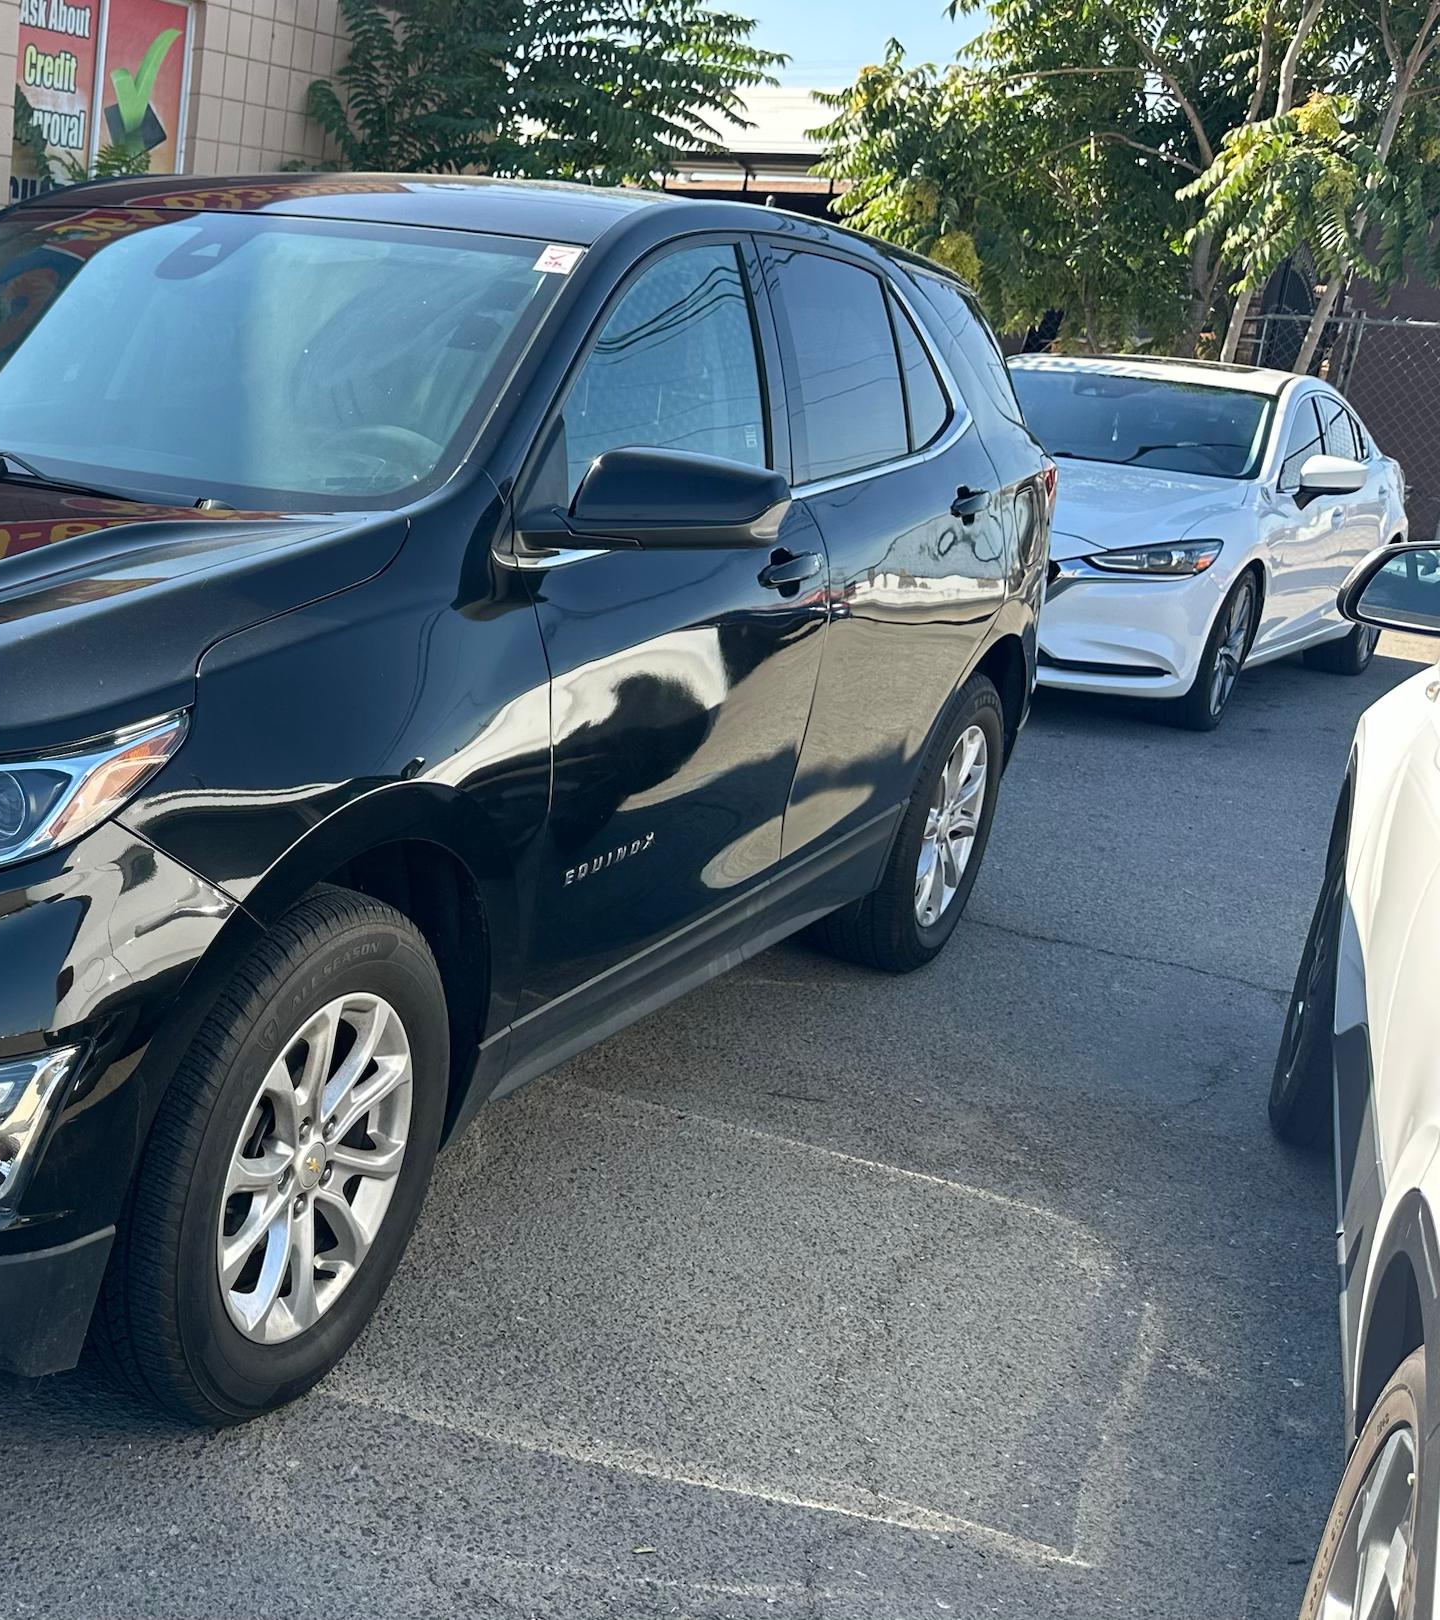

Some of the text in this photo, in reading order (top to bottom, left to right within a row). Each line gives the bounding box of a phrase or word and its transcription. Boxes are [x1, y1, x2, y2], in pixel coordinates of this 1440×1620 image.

[48, 0, 92, 39] About
[23, 43, 77, 94] Credit
[563, 831, 655, 887] EQUINOX
